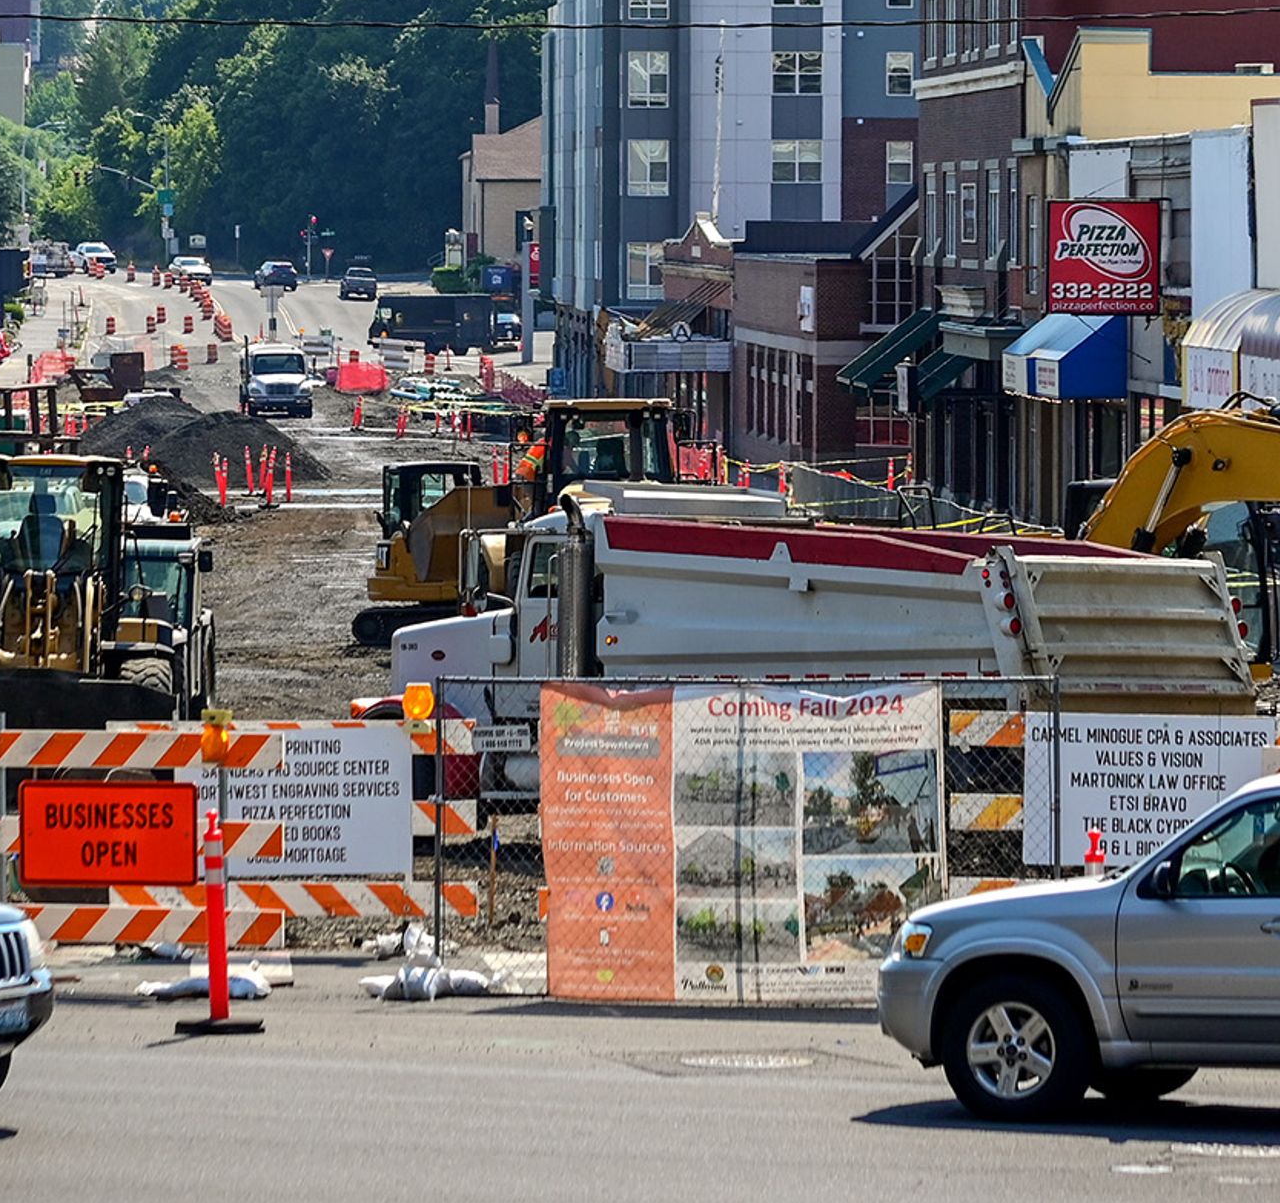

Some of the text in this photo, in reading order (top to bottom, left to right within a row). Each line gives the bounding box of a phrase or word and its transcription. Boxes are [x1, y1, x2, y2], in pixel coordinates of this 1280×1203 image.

[1076, 223, 1127, 242] PIZZA
[1057, 242, 1140, 258] PERFECTION
[1051, 282, 1153, 299] 332-2222
[1051, 300, 1154, 312] pizzaperfection.co
[708, 694, 905, 722] Coming Fall 2024
[1086, 727, 1142, 745] MINOGUE
[1146, 728, 1170, 745] CPA
[1174, 729, 1183, 745] &
[1189, 730, 1268, 746] ASSOCIATES
[285, 739, 342, 755] PRINTING
[1096, 750, 1203, 768] VALUES & VISION
[294, 761, 340, 777] SOURCE
[343, 760, 390, 776] CENTER
[556, 770, 655, 787] Businesses Open
[1070, 772, 1227, 791] MARTONICK LAW OFFICE
[272, 782, 339, 798] ENGRAVING
[343, 781, 400, 797] SERVICES
[565, 789, 647, 803] for Customers
[241, 804, 351, 820] PIZZA PERFECTION
[1109, 794, 1187, 813] ETSI BRAVO
[45, 803, 174, 829] BUSINESSES
[302, 825, 341, 842] BOOKS
[1082, 816, 1107, 833] THE
[1111, 817, 1152, 834] BLACK
[80, 841, 138, 867] OPEN
[547, 838, 667, 854] Information Sources
[1112, 840, 1121, 856] &
[1125, 841, 1132, 856] L
[284, 847, 347, 863] MORTGAGE
